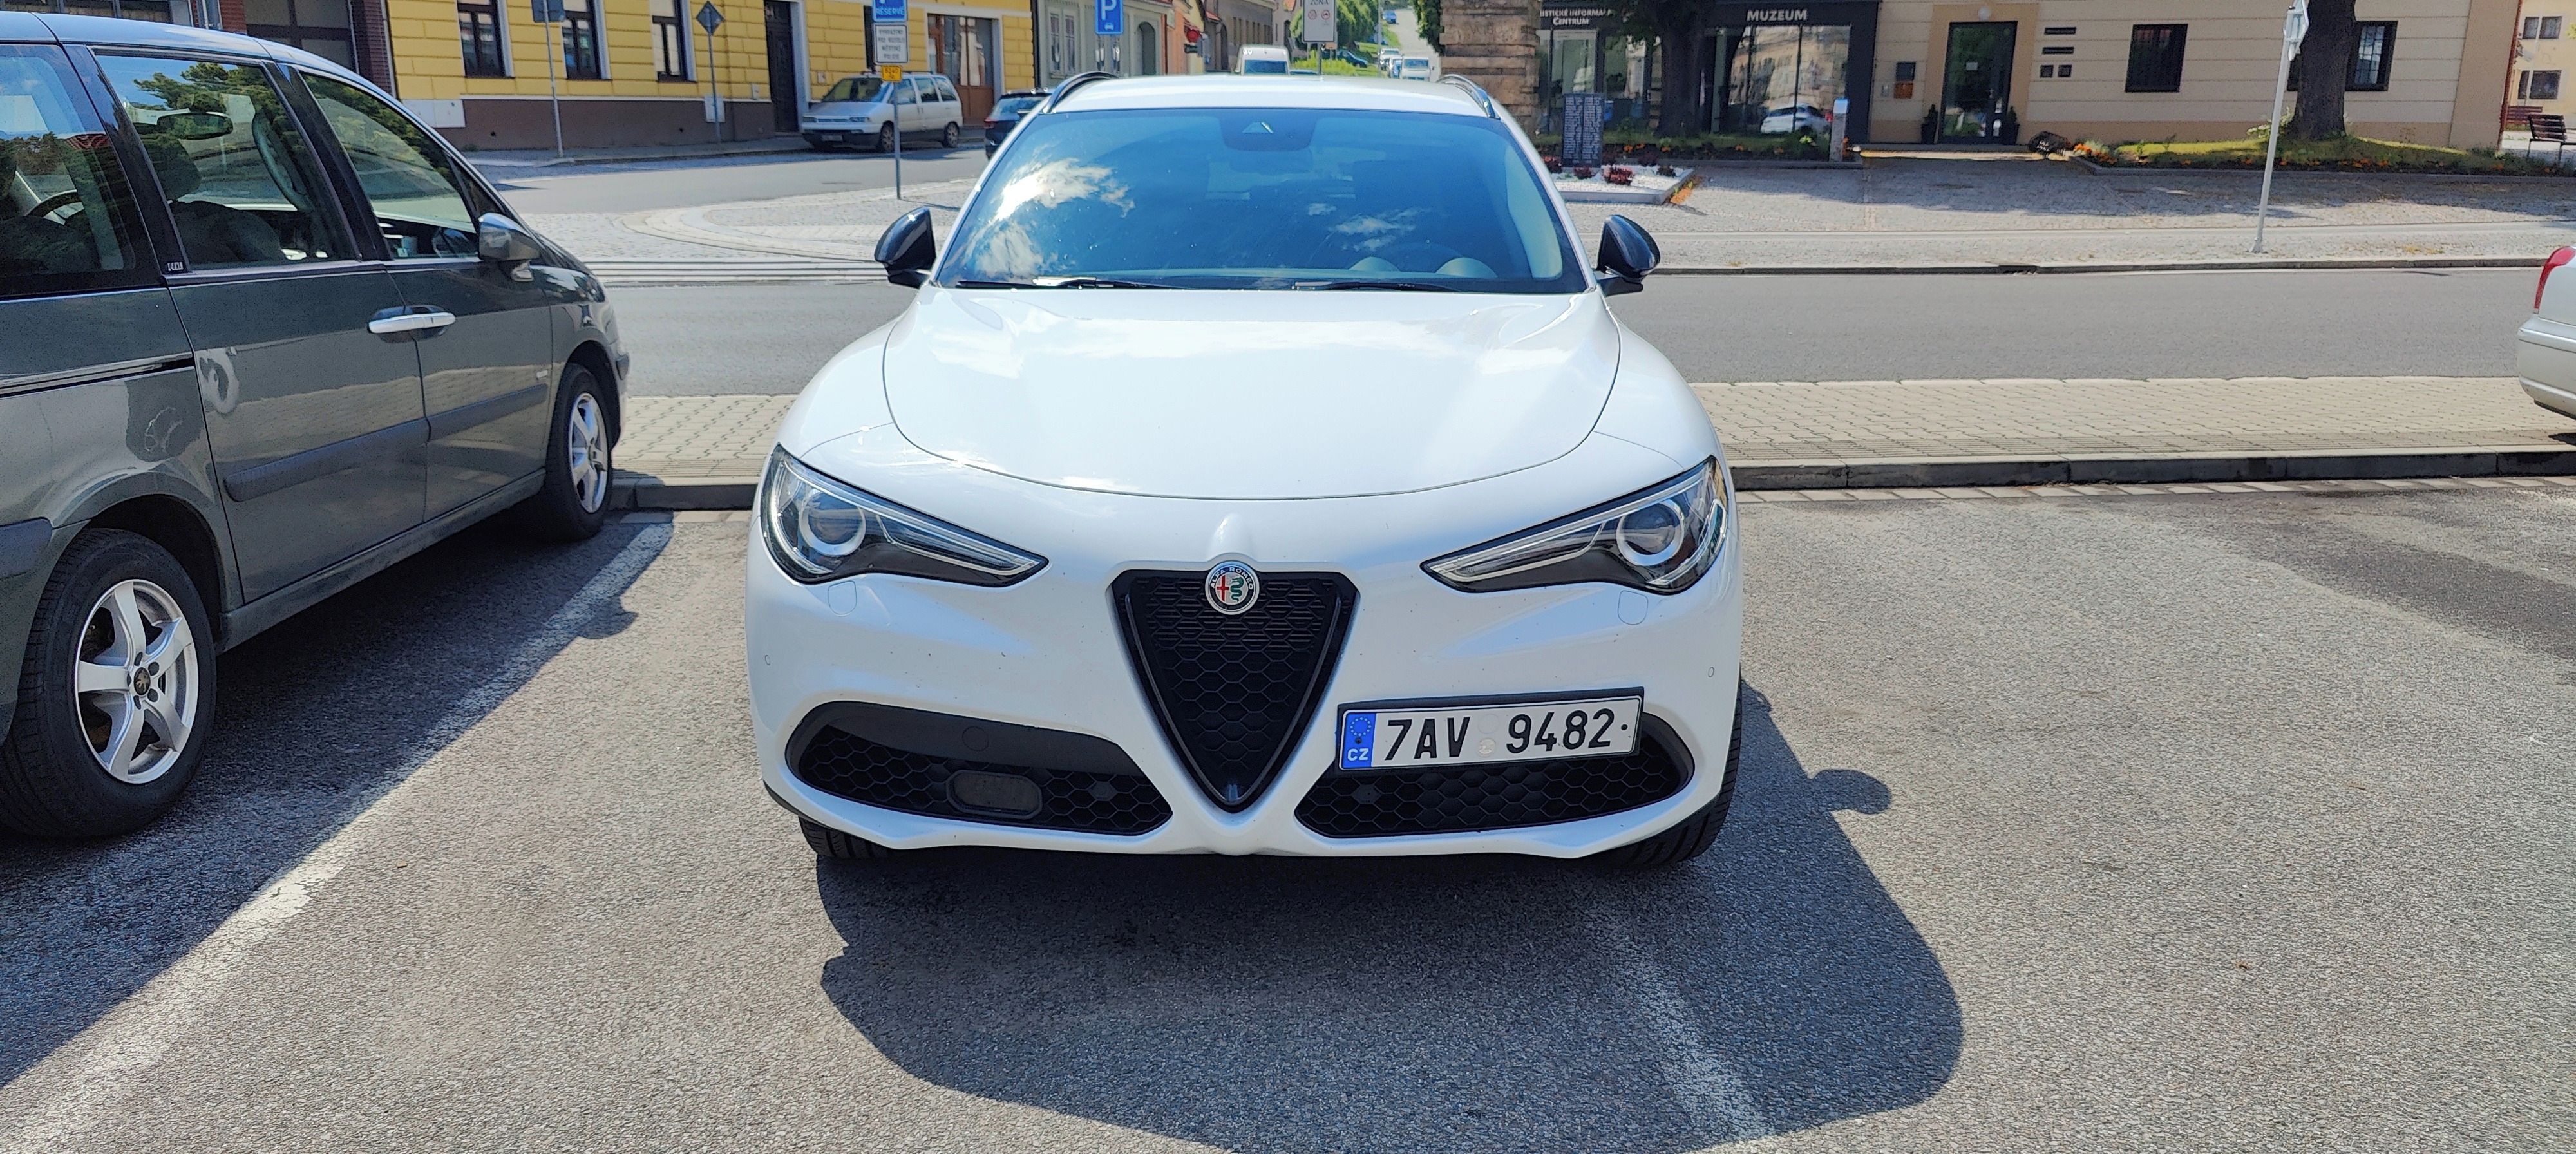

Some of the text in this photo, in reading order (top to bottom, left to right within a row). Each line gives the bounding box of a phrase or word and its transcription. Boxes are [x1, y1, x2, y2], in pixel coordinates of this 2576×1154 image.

[1101, 0, 1117, 21] P
[1746, 9, 1808, 21] MUZEUM
[1553, 17, 1589, 25] CENTRUM
[1211, 567, 1254, 590] ALFA ROMEO
[1385, 708, 1615, 761] 7AV 9482
[1347, 748, 1370, 761] CZ
